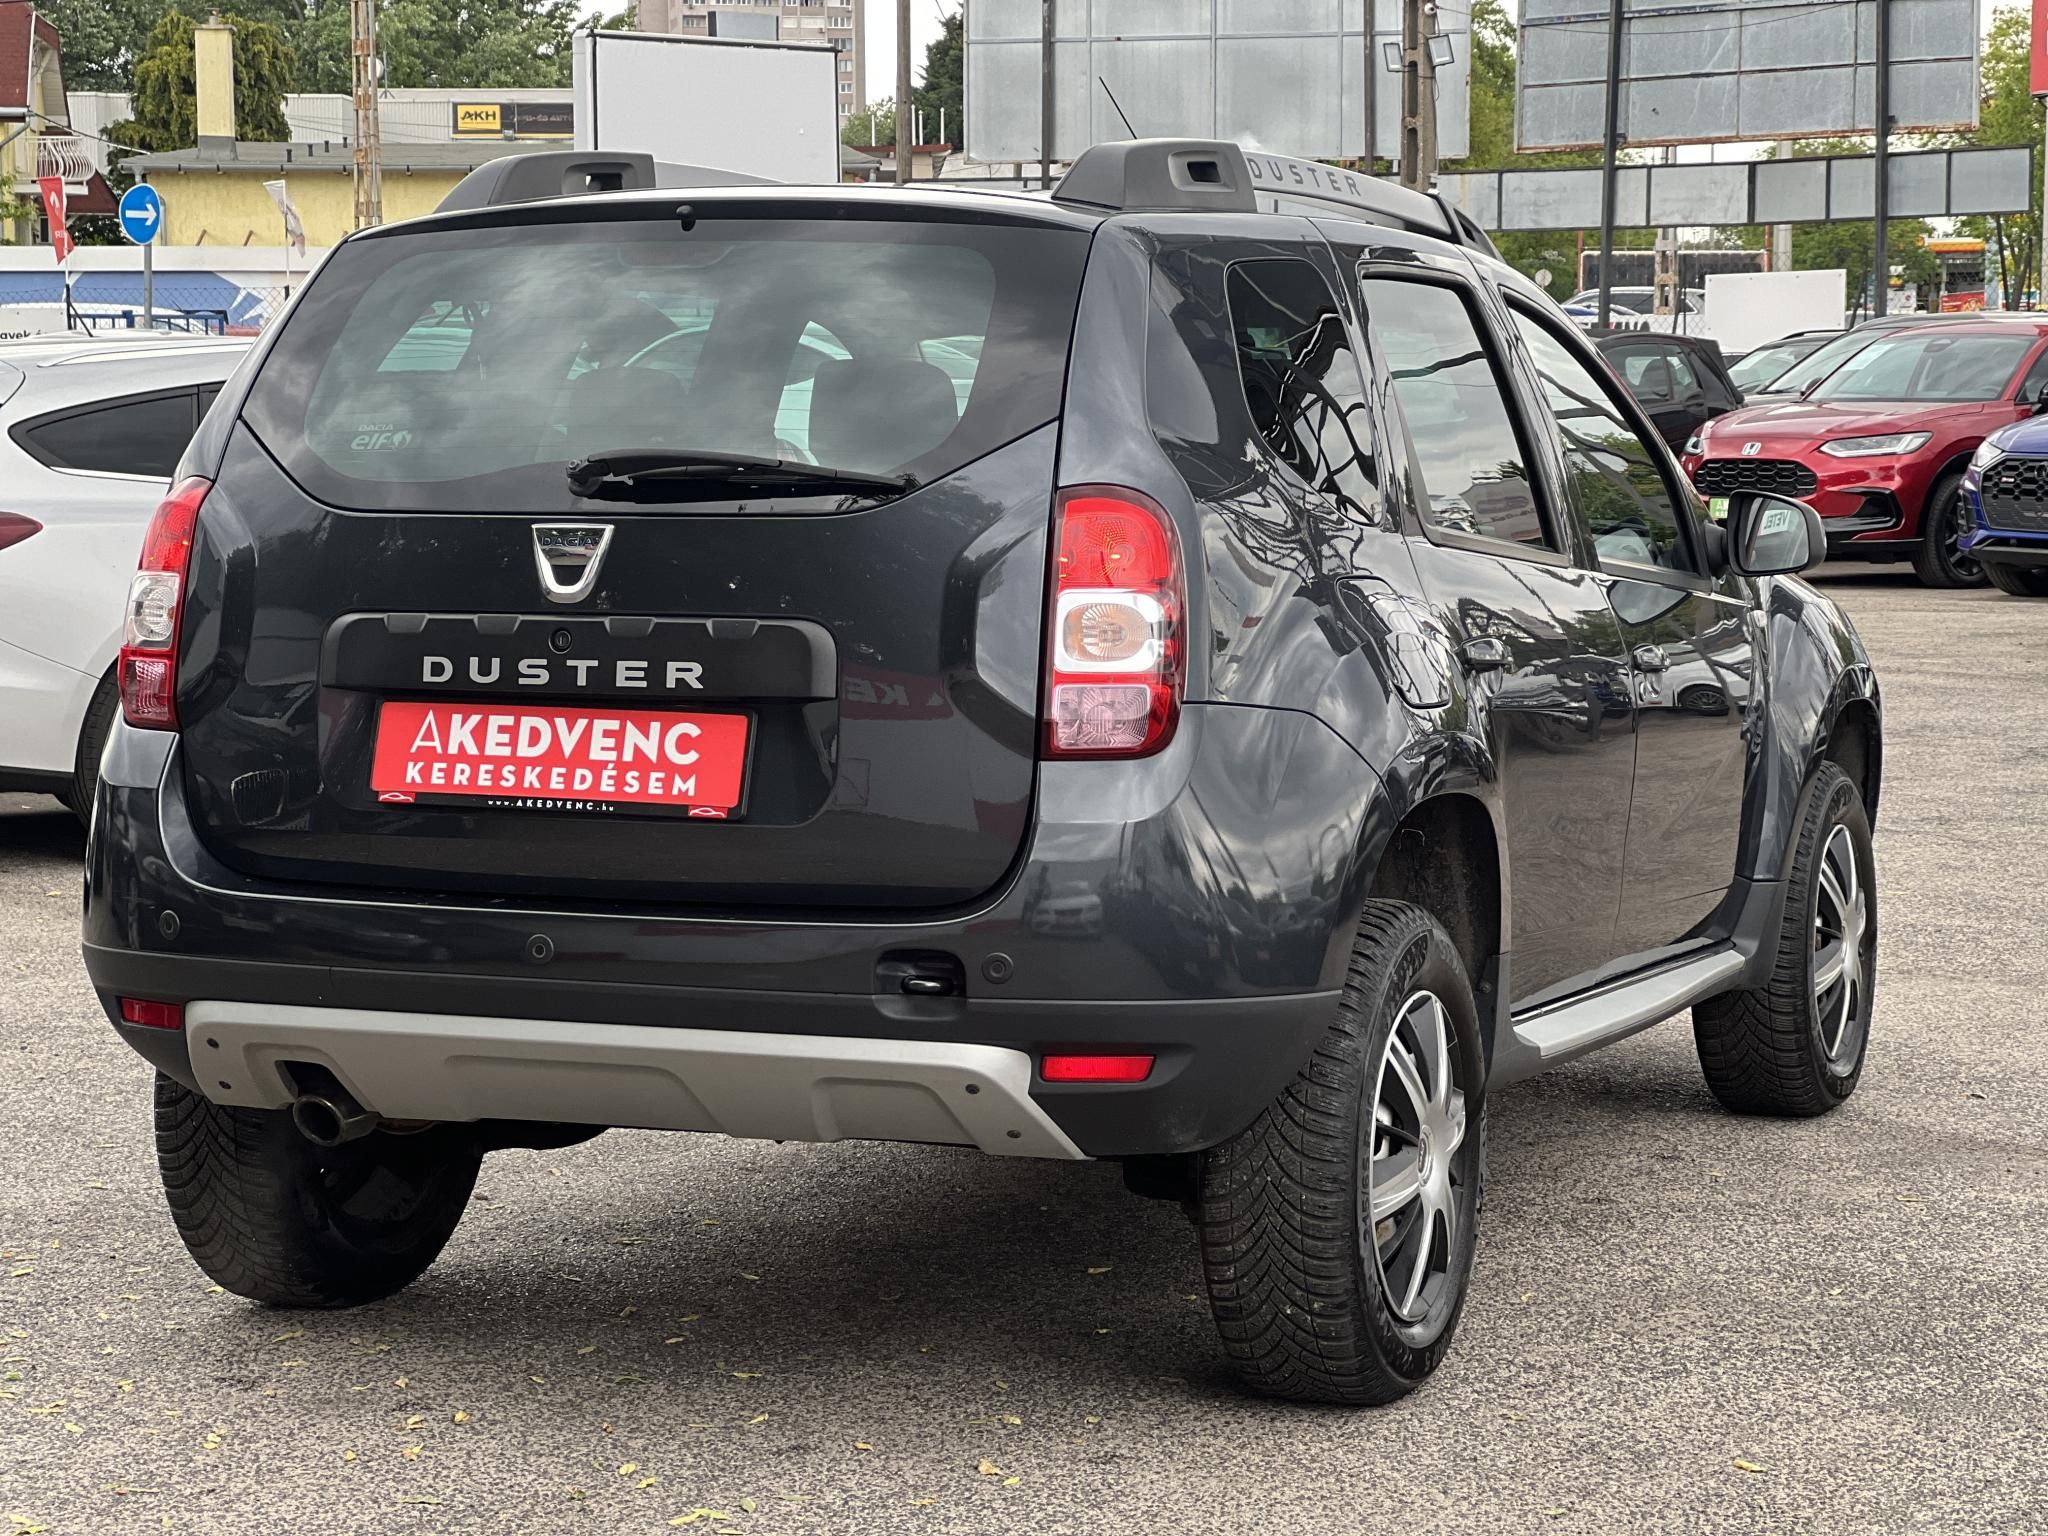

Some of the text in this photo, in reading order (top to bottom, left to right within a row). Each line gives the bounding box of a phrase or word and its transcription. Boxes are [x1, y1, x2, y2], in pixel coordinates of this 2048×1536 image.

[461, 110, 496, 121] AKH
[1246, 157, 1362, 197] DUSTER
[351, 433, 392, 450] elf
[541, 537, 594, 546] DACIA
[422, 655, 704, 688] DUSTER
[410, 709, 702, 766] AKEDVENC
[405, 761, 697, 797] KERESKEDÉSEM
[487, 799, 614, 811] www.AKEDVENC.hu
